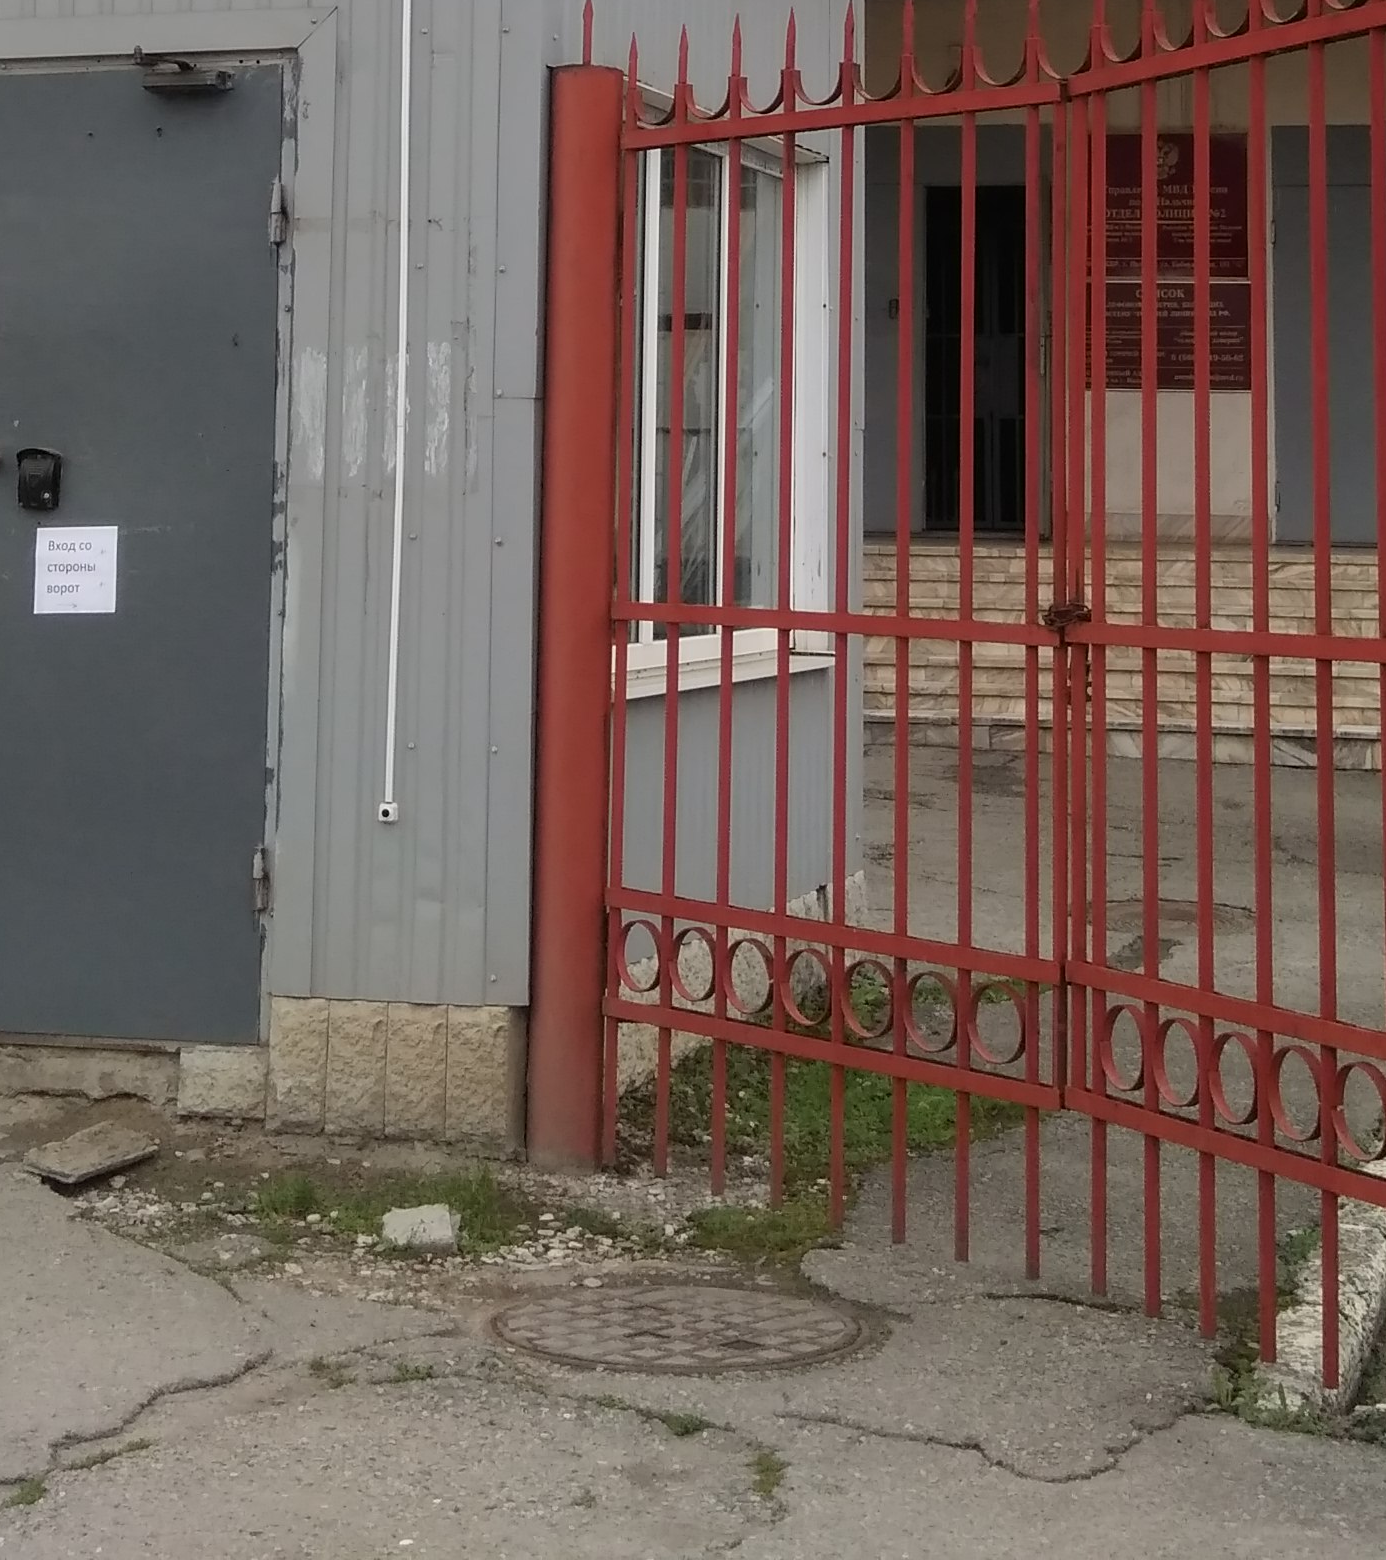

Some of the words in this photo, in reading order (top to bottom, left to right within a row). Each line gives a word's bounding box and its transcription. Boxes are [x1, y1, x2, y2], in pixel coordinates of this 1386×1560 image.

[48, 540, 76, 552] Вход
[79, 542, 92, 550] со
[47, 563, 96, 574] стороны
[47, 584, 80, 595] ворот
